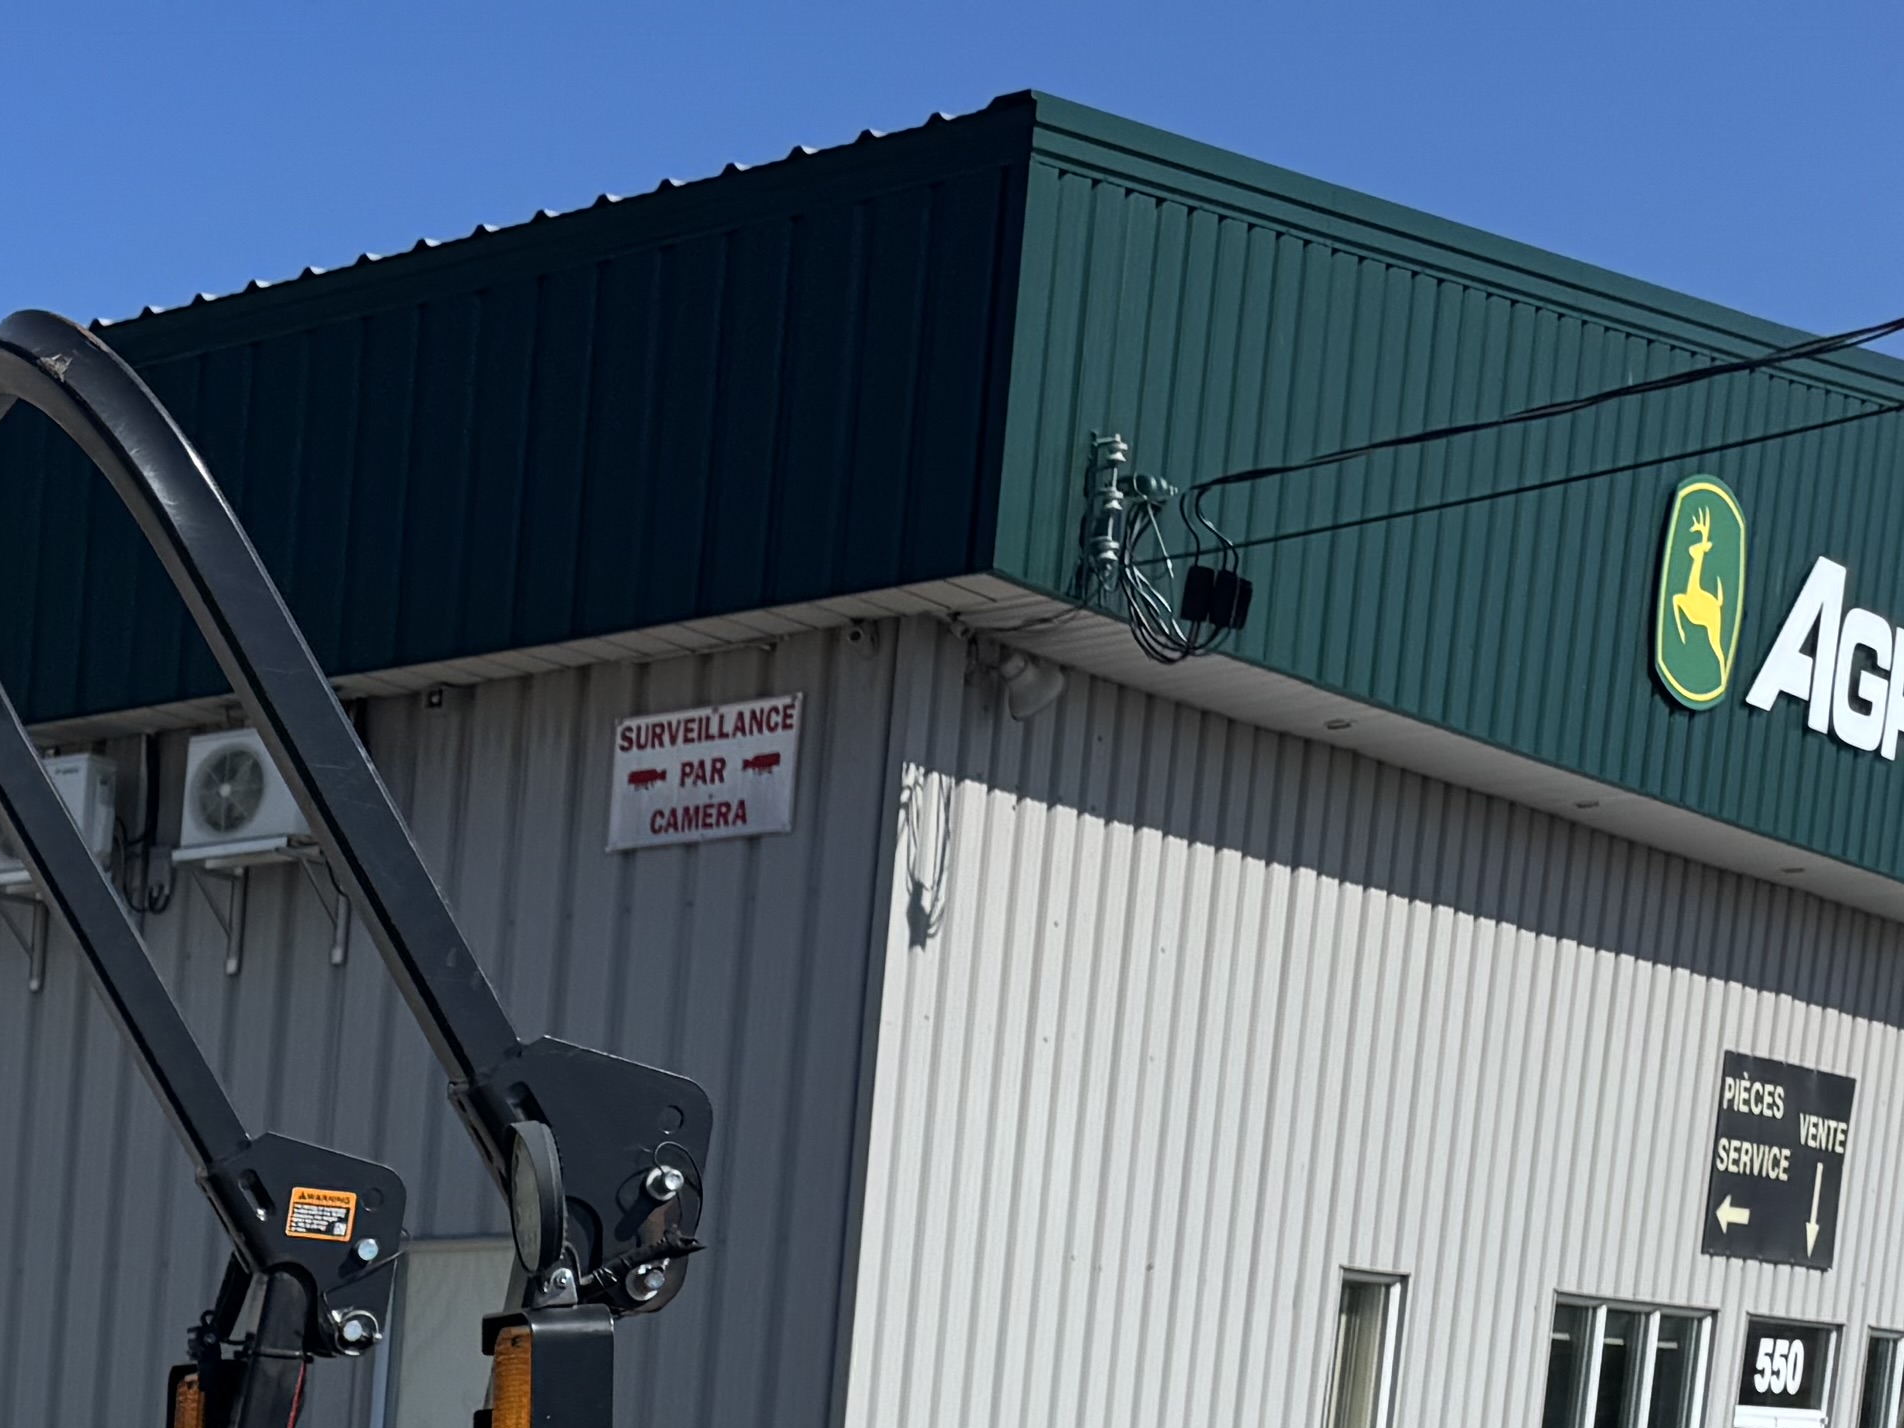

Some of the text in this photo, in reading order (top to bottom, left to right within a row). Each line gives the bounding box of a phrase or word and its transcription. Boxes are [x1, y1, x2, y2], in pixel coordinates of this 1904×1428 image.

[618, 703, 796, 752] SURVEILLANCE
[680, 757, 727, 787] PAR
[1723, 1072, 1785, 1120] PIÈCES
[1799, 1113, 1848, 1154] VENTE
[1716, 1137, 1791, 1181] SERVICE
[1754, 1338, 1804, 1395] 550
